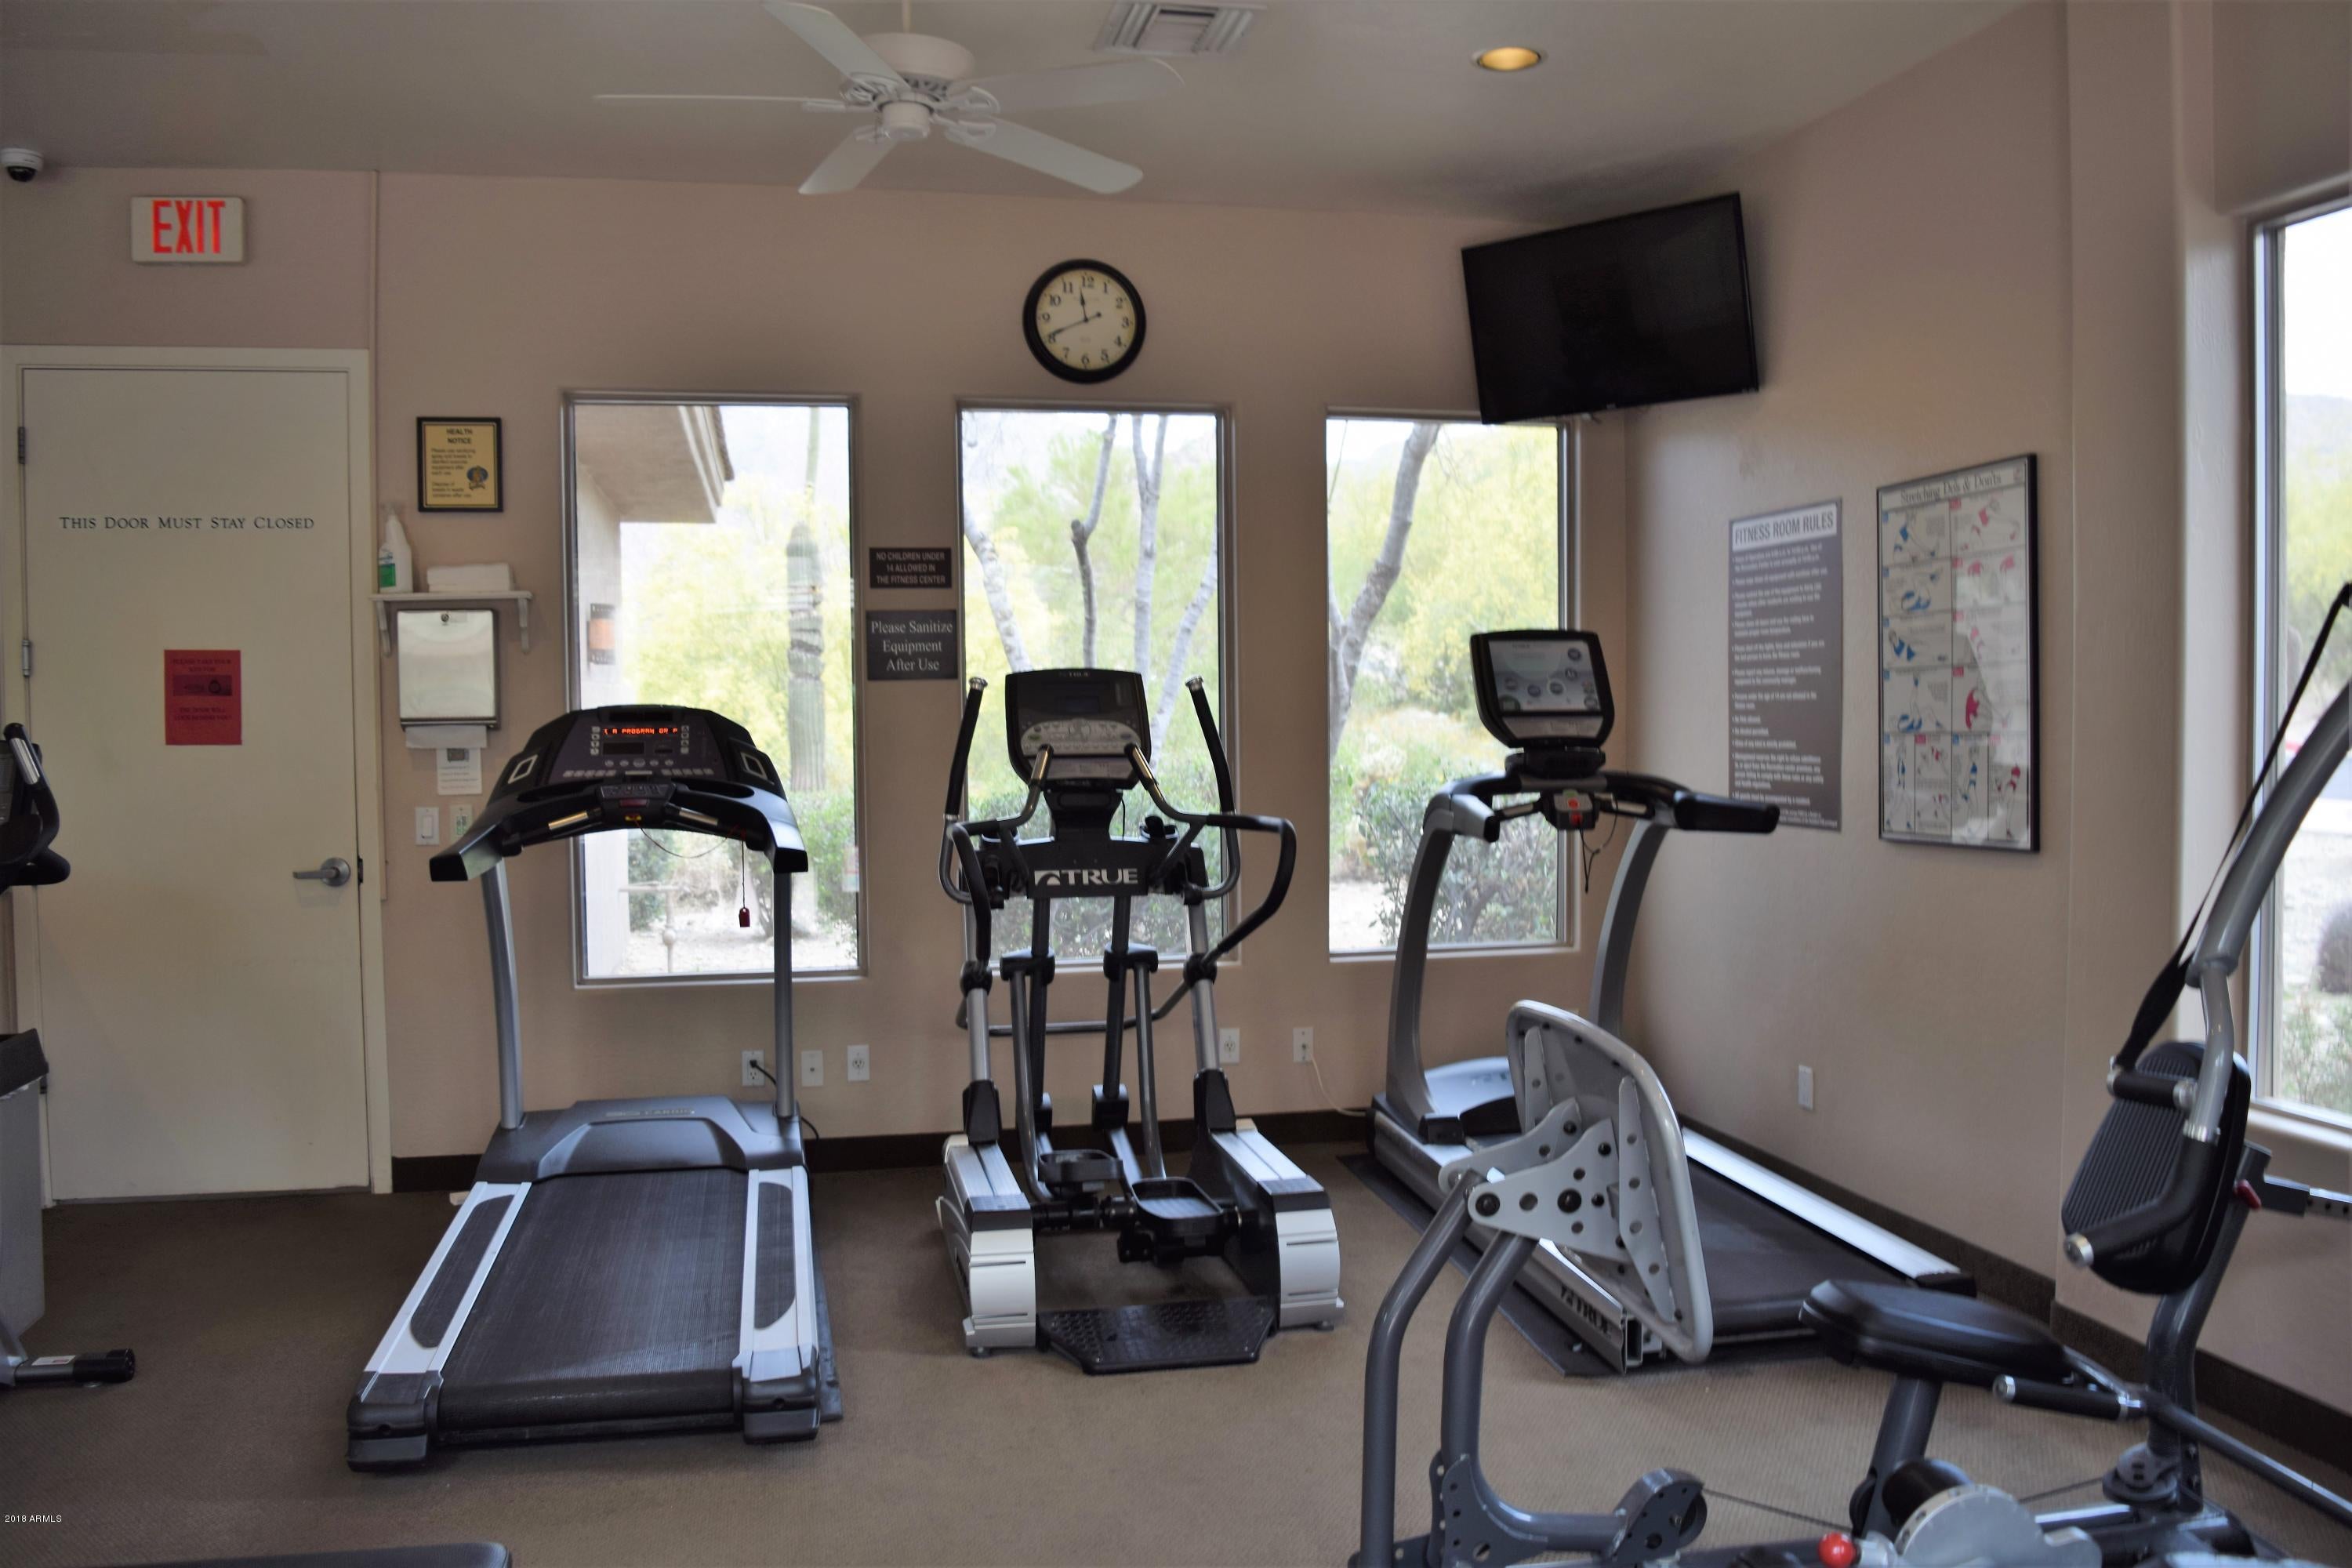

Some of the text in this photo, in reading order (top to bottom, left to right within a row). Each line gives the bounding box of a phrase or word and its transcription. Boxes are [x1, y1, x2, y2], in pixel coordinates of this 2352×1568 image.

[152, 199, 226, 255] EXIT
[1062, 281, 1074, 294] 11
[1081, 275, 1094, 289] 12
[1102, 281, 1109, 294] 1
[1049, 294, 1062, 307] 10
[1116, 297, 1123, 309] 2
[1042, 313, 1051, 323] 9
[1121, 316, 1130, 328] 3
[1114, 336, 1122, 347] 4
[1062, 347, 1069, 358] 7
[1080, 353, 1090, 364] 6
[1100, 349, 1109, 361] 5
[1900, 484, 1940, 504] Stretching
[1734, 510, 1834, 546] FITNESS ROOM RULES
[876, 551, 946, 561] NO CHILDREN UNDER
[887, 563, 936, 572] 14 ALLOWED IN
[876, 575, 946, 584] THE FITNESS CENTER
[871, 619, 953, 634] Please Sanitize
[883, 638, 942, 656] Equipment
[886, 658, 940, 672] After Use
[1061, 868, 1138, 886] TRUE
